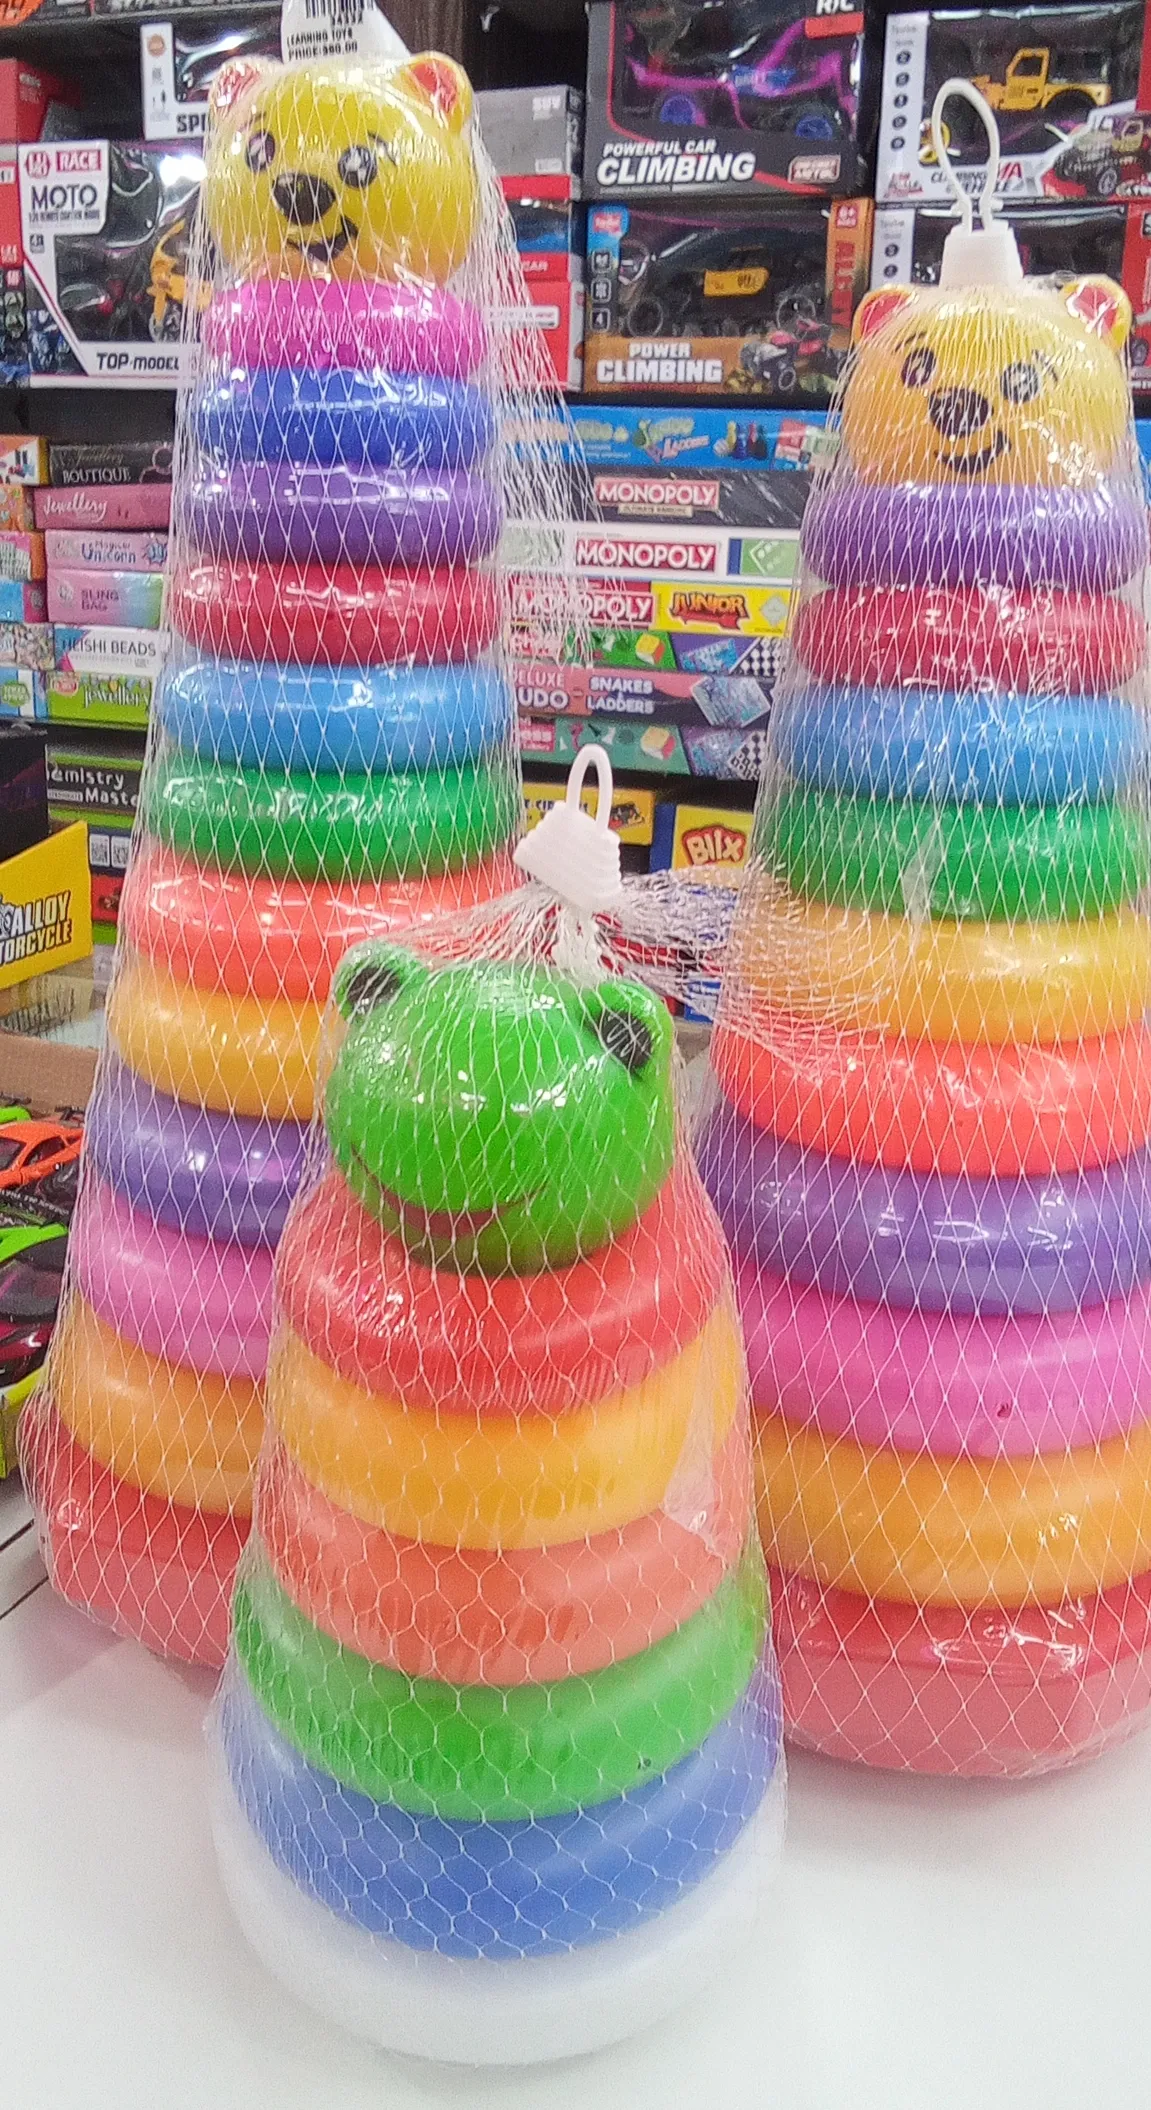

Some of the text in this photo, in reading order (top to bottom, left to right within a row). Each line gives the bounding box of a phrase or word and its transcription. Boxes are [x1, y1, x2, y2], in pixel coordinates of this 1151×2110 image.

[602, 138, 717, 158] POWERFUL CAR
[60, 152, 98, 171] RACE
[596, 152, 756, 185] CLIMBING
[31, 184, 97, 210] MOTO
[629, 342, 691, 358] POWER
[597, 360, 723, 384] CLIMBING
[62, 467, 131, 483] BOUTIQUE
[598, 481, 715, 506] MONOPOLY
[43, 492, 107, 523] Jewellery
[576, 540, 715, 569] MONOPOLY
[670, 592, 749, 619] JUNIOR
[111, 639, 156, 657] BEADS
[589, 675, 654, 695] SNAKES
[517, 686, 570, 710] UDO
[586, 695, 657, 715] LADDERS
[10, 889, 70, 938] ALLOY
